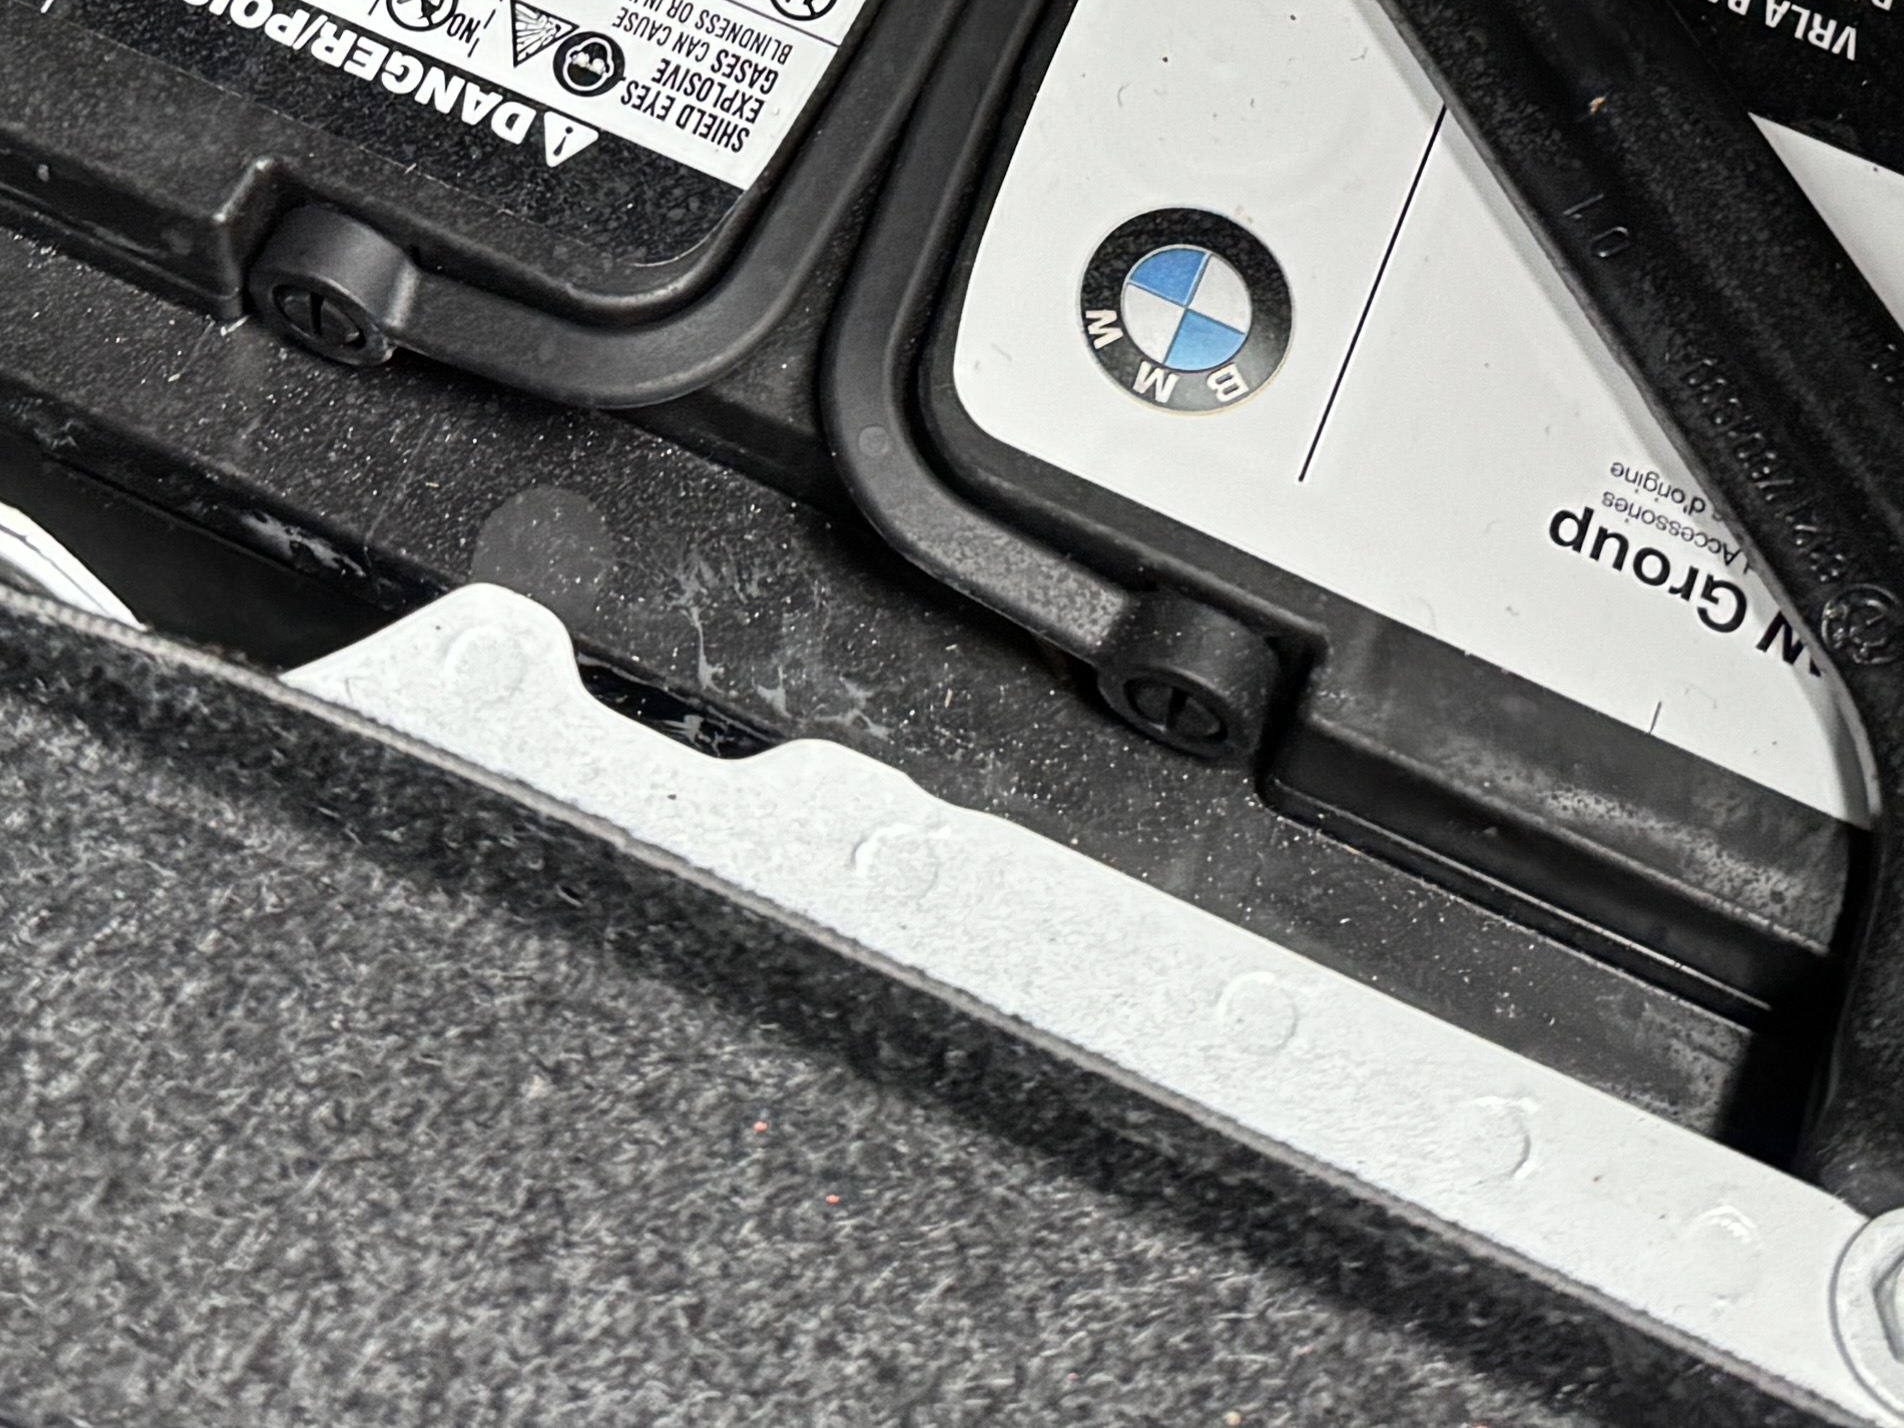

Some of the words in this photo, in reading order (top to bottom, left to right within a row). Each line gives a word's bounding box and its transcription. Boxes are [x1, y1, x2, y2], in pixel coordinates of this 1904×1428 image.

[445, 12, 481, 44] NO
[611, 6, 672, 46] CAUSE
[670, 30, 710, 63] CAN
[693, 8, 793, 65] BLINDNESS
[650, 57, 765, 124] EXPLOSIVE
[709, 48, 779, 95] GASES
[674, 103, 750, 153] SHIELD
[1609, 461, 1707, 516] d'origine
[1601, 490, 1742, 567] Accessories
[1548, 506, 1748, 633] Group
